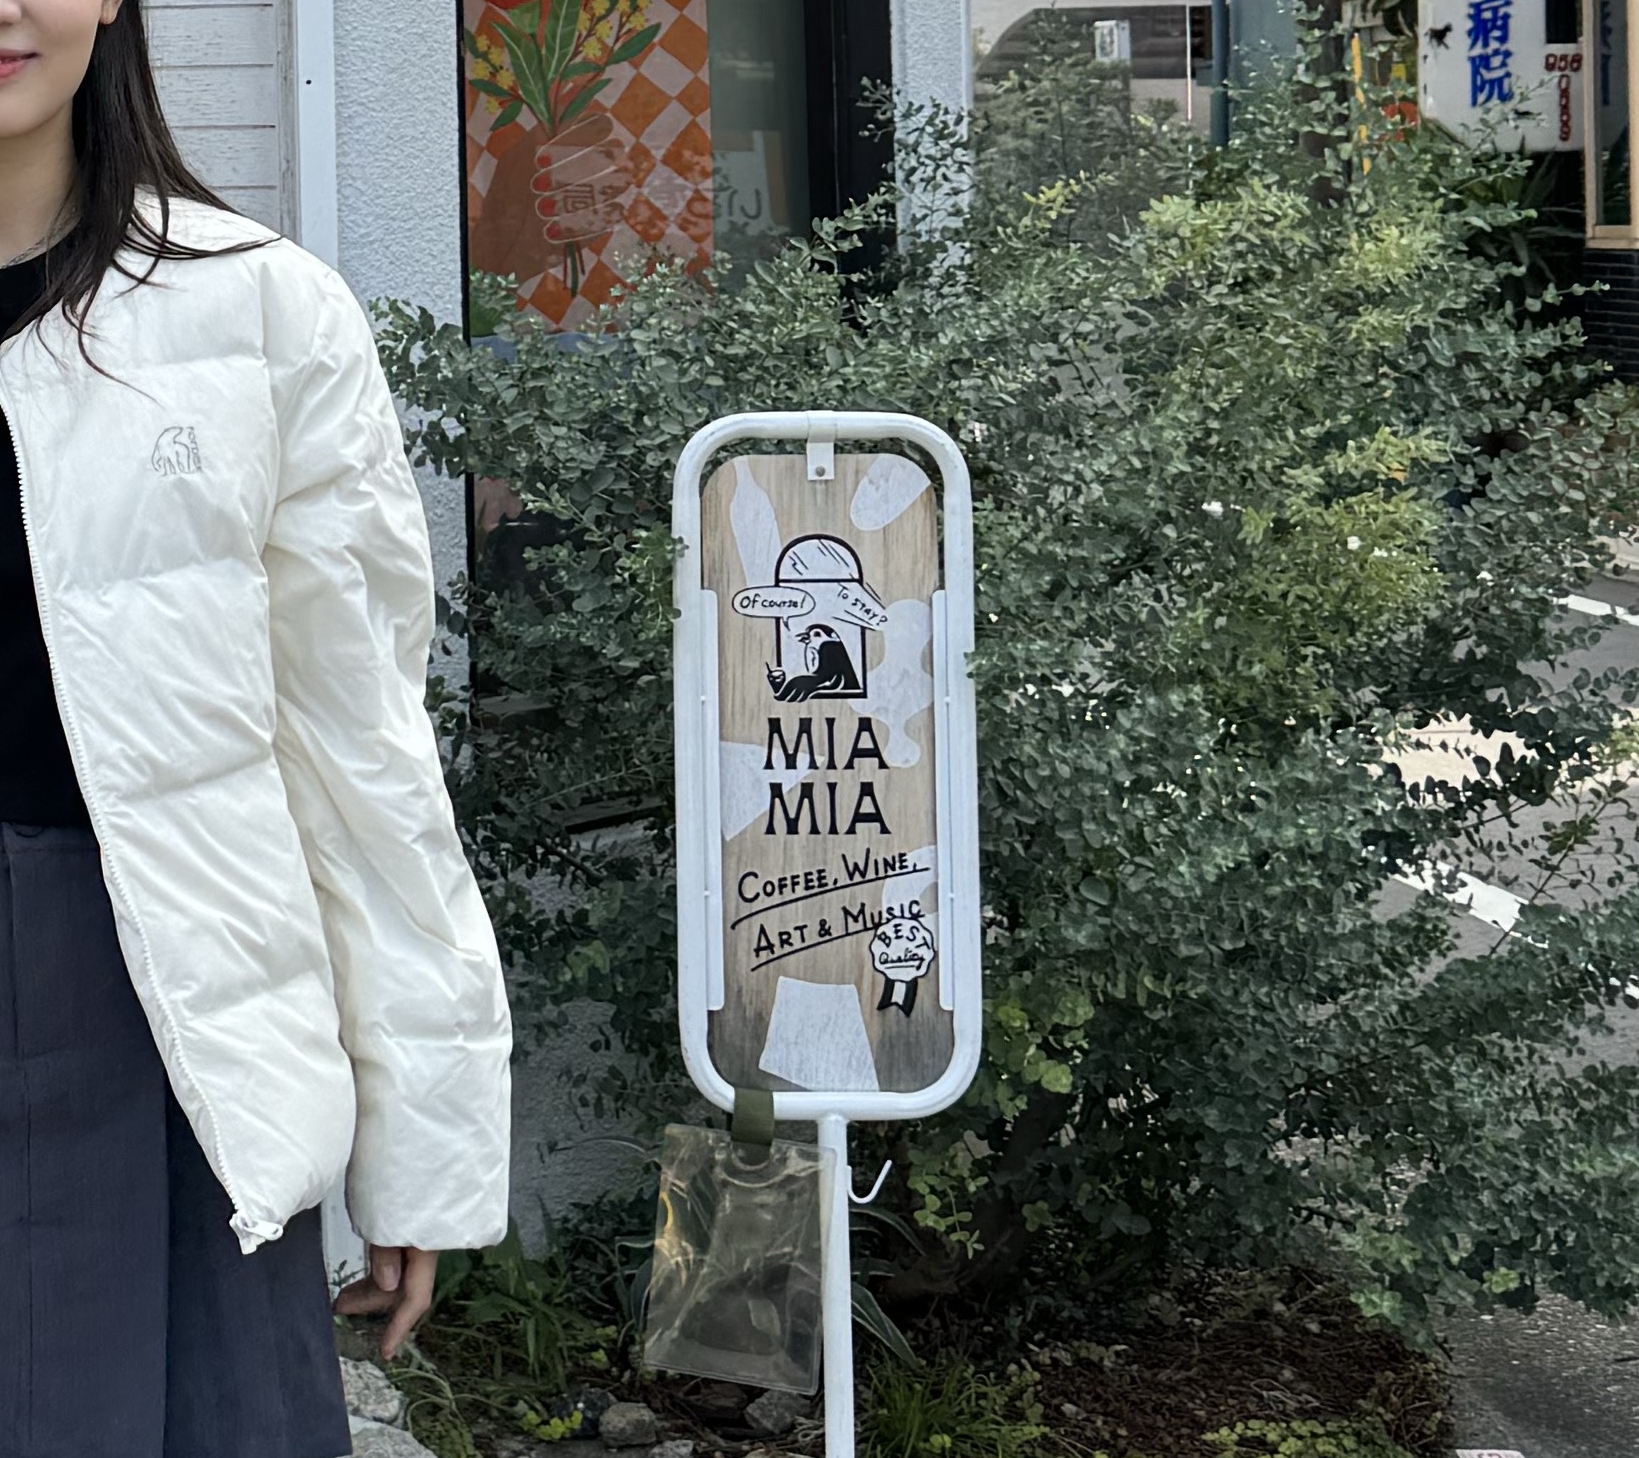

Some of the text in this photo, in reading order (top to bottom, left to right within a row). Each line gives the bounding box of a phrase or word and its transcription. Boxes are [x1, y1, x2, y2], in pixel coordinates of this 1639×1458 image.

[739, 593, 807, 610] Of course!
[763, 717, 890, 770] MIA
[764, 781, 892, 835] MIA
[754, 923, 808, 958] ART
[818, 918, 832, 936] &
[877, 923, 931, 950] BEST
